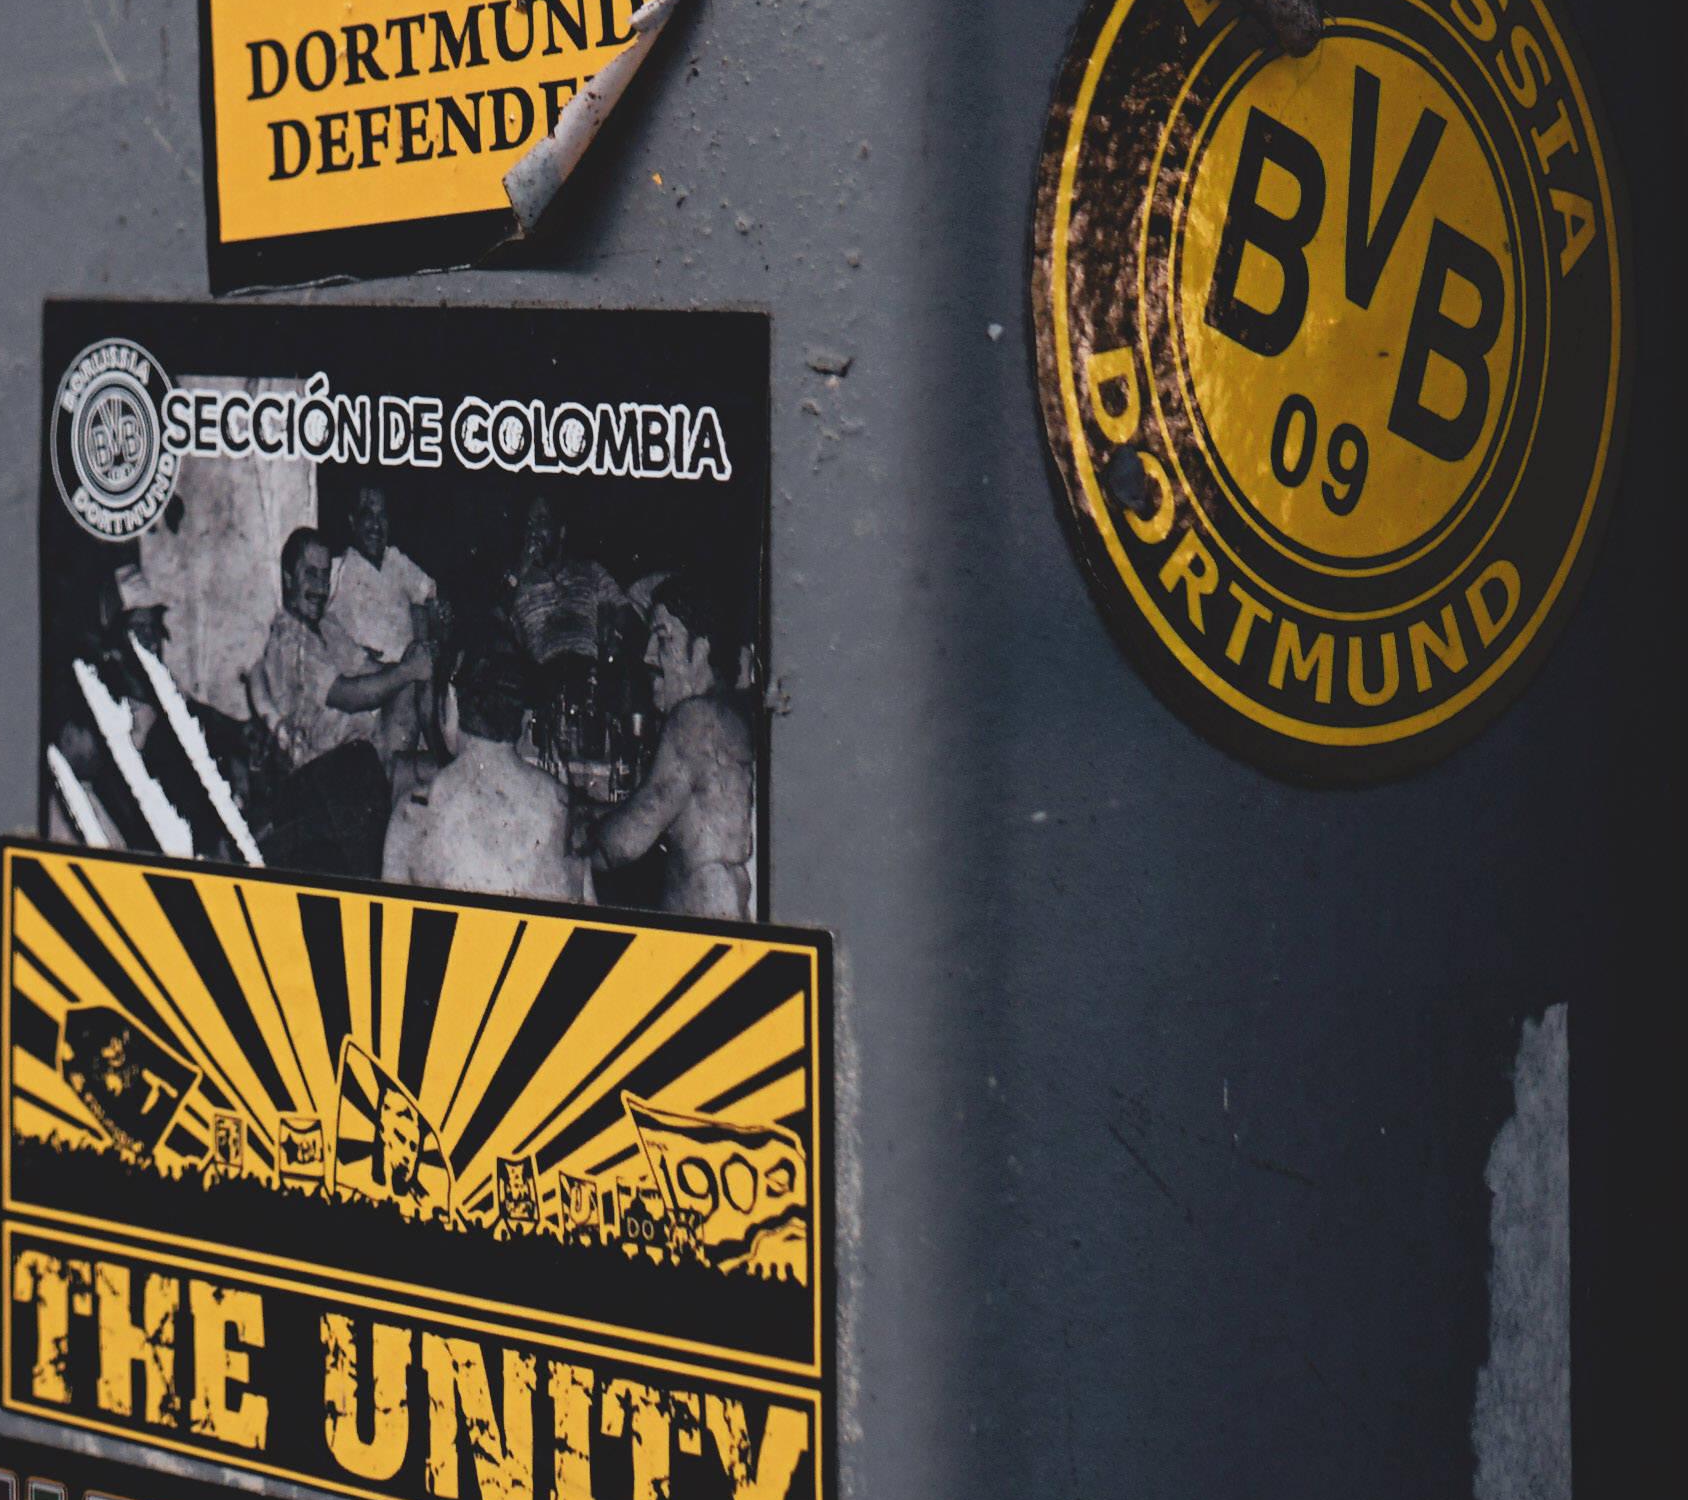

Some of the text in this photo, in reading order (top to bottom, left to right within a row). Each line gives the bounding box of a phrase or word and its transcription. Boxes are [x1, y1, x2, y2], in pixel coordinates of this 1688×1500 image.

[267, 76, 597, 182] DEFENDE
[1203, 65, 1507, 463] BVB
[161, 371, 732, 481] SECCIÓN DE COLOMBIA
[1269, 392, 1370, 517] 09
[1082, 346, 1522, 709] DORTMUND
[11, 1249, 269, 1452] THE
